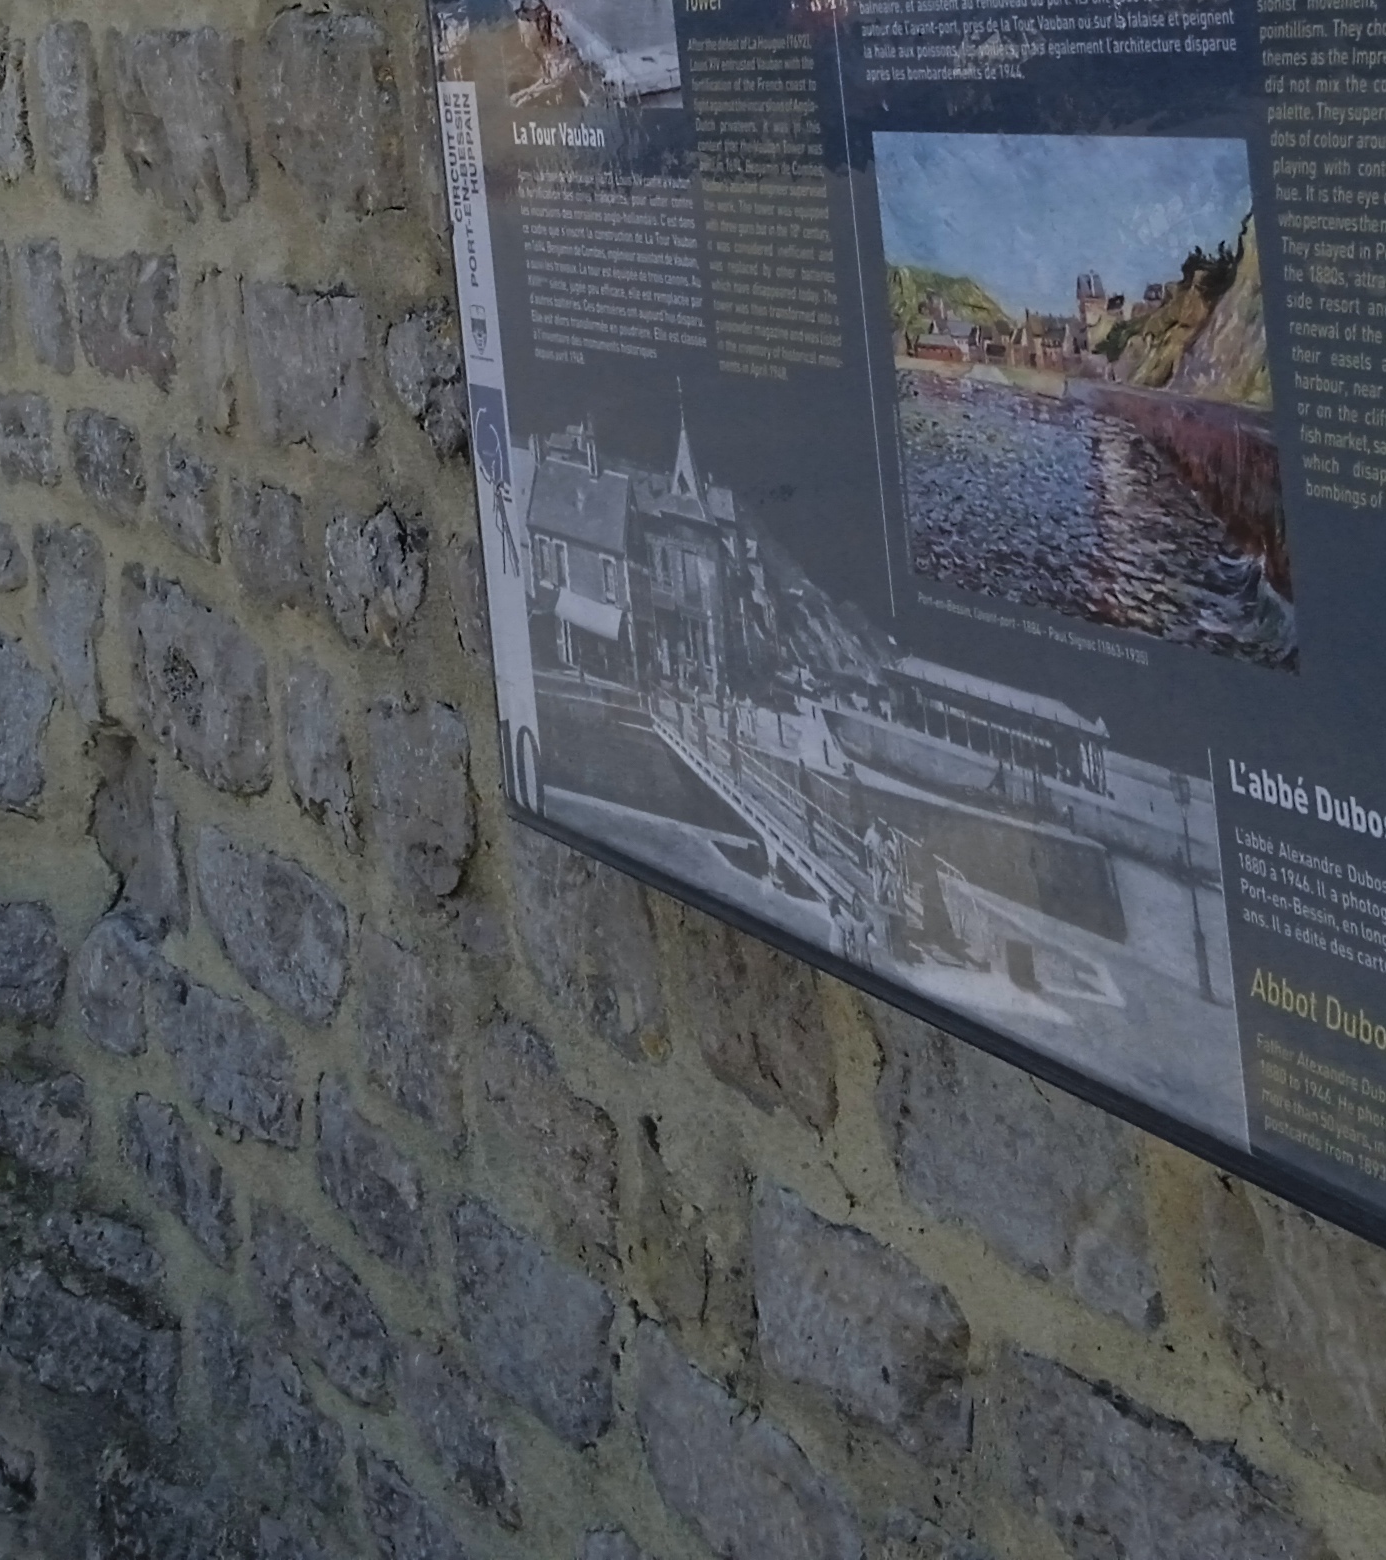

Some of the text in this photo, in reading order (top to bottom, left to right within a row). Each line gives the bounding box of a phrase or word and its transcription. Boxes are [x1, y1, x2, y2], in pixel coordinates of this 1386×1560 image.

[1261, 49, 1308, 67] themes
[1310, 50, 1326, 67] as
[1327, 47, 1349, 66] the
[1264, 75, 1285, 95] did
[1289, 76, 1311, 94] not
[1314, 78, 1341, 93] mix
[1344, 73, 1369, 94] the
[462, 93, 479, 194] HUPPAIN
[512, 120, 606, 148] La Tour Vauban
[442, 93, 463, 223] CIRCUIT DE
[1272, 156, 1318, 181] playing
[1323, 158, 1352, 177] with
[453, 93, 479, 288] PORT-EN-BESSIN
[1281, 235, 1311, 260] They
[1313, 240, 1356, 263] stayed
[1358, 245, 1372, 260] in
[1288, 320, 1340, 340] renewal
[1343, 323, 1358, 342] of
[1360, 324, 1383, 345] the
[1291, 344, 1322, 364] their
[1329, 352, 1373, 372] easels
[1294, 370, 1349, 398] harbour,
[1352, 381, 1384, 400] near
[1305, 478, 1368, 510] bombings
[1369, 489, 1384, 509] of
[1278, 840, 1343, 879] Alexandre
[1238, 851, 1268, 879] 1880
[1280, 866, 1315, 895] 1946.
[1315, 878, 1327, 900] Il
[1330, 887, 1339, 904] a
[1239, 876, 1341, 933] Port-en-Bessin,
[1341, 918, 1359, 937] en
[1242, 907, 1269, 929] ans.
[1271, 913, 1282, 935] Il
[1283, 922, 1293, 938] a
[1329, 937, 1355, 962] des
[1249, 967, 1318, 1023] Abbot
